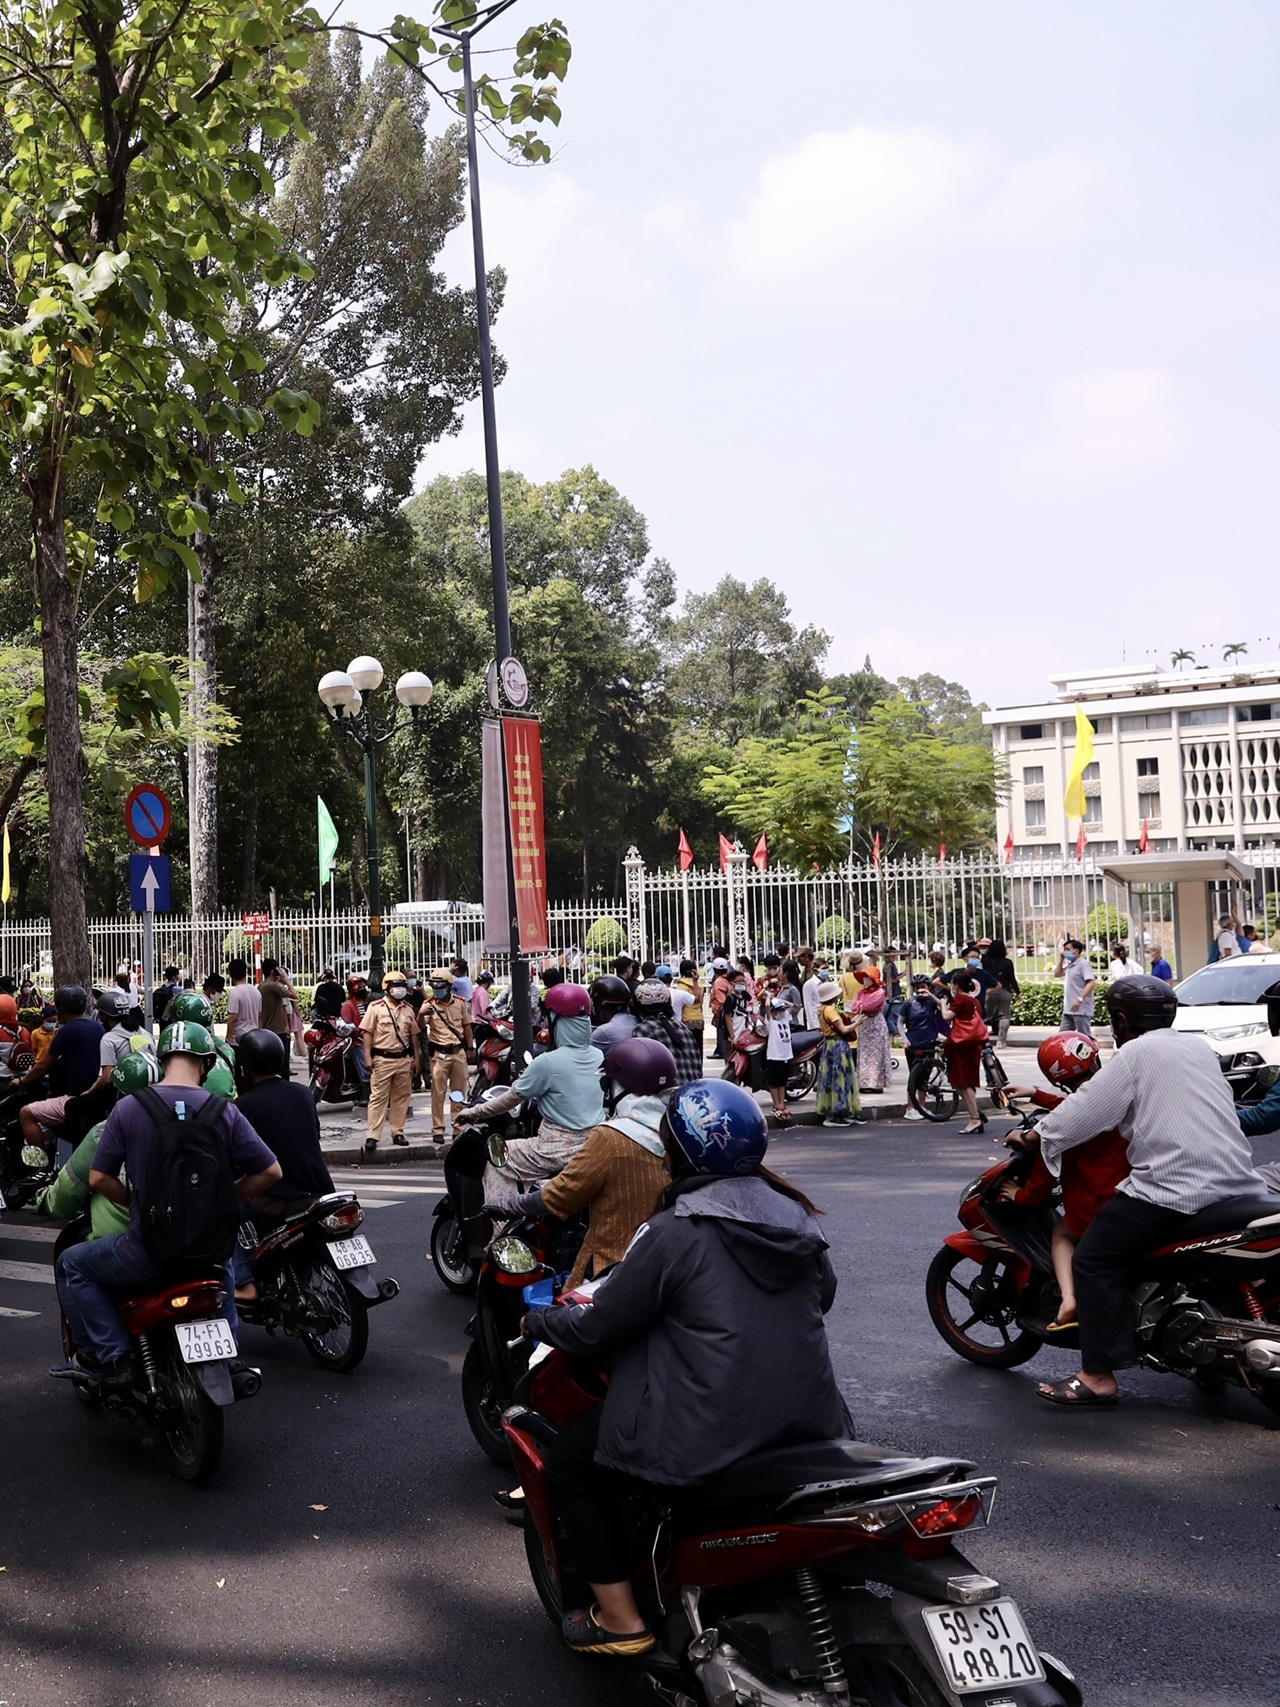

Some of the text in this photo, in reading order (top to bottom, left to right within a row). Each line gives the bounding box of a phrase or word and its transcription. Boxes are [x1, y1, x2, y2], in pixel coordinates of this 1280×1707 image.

[334, 1238, 363, 1253] 48-AB
[1174, 1234, 1242, 1253] NOUVO
[337, 1250, 373, 1268] 068.35
[185, 1323, 221, 1342] 74-F1
[185, 1339, 232, 1360] 299.63
[939, 1605, 1010, 1645] 59-S1
[948, 1642, 1036, 1686] 488.20
